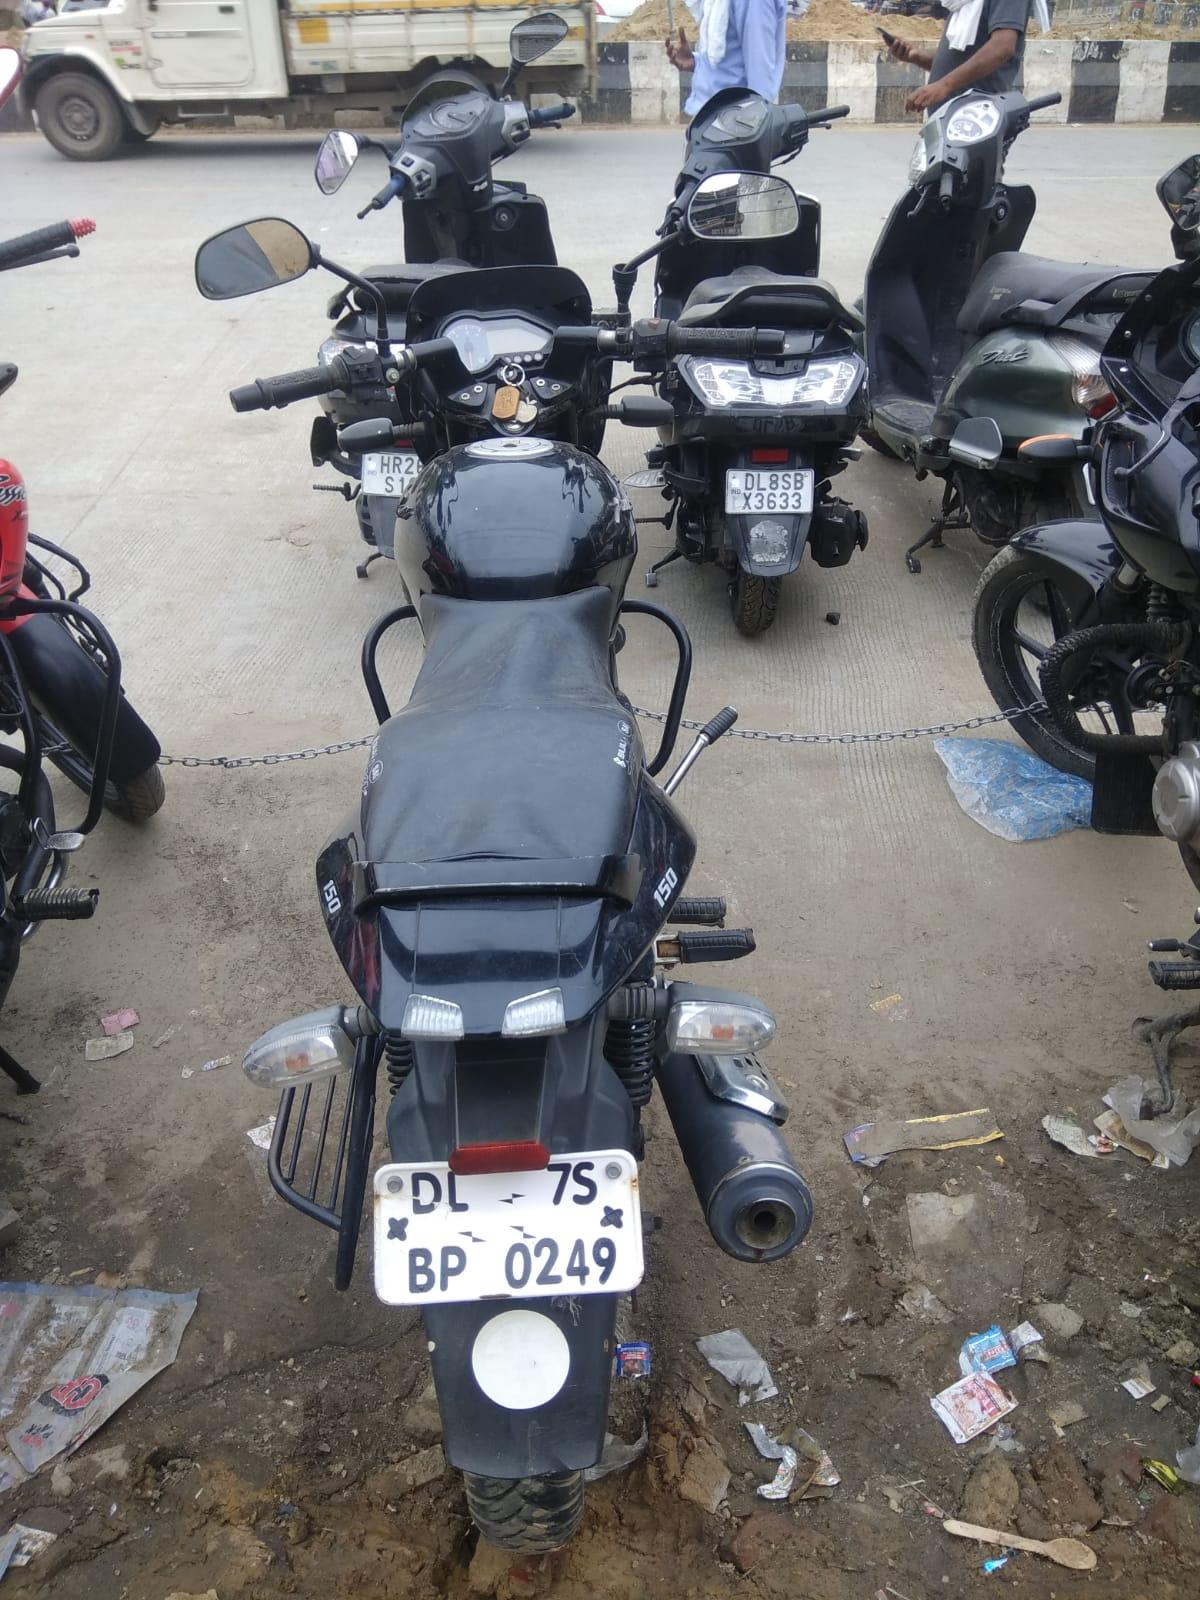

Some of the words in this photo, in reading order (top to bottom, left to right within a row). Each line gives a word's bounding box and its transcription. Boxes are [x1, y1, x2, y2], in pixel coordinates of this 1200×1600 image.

[385, 476, 418, 493] S1
[744, 472, 804, 491] DL8SB
[742, 492, 802, 510] X3633
[323, 879, 342, 914] 150
[653, 866, 678, 908] 150
[411, 1171, 470, 1215] DL
[547, 1161, 598, 1206] 7S
[408, 1245, 467, 1294] BP
[504, 1237, 617, 1290] 0249
